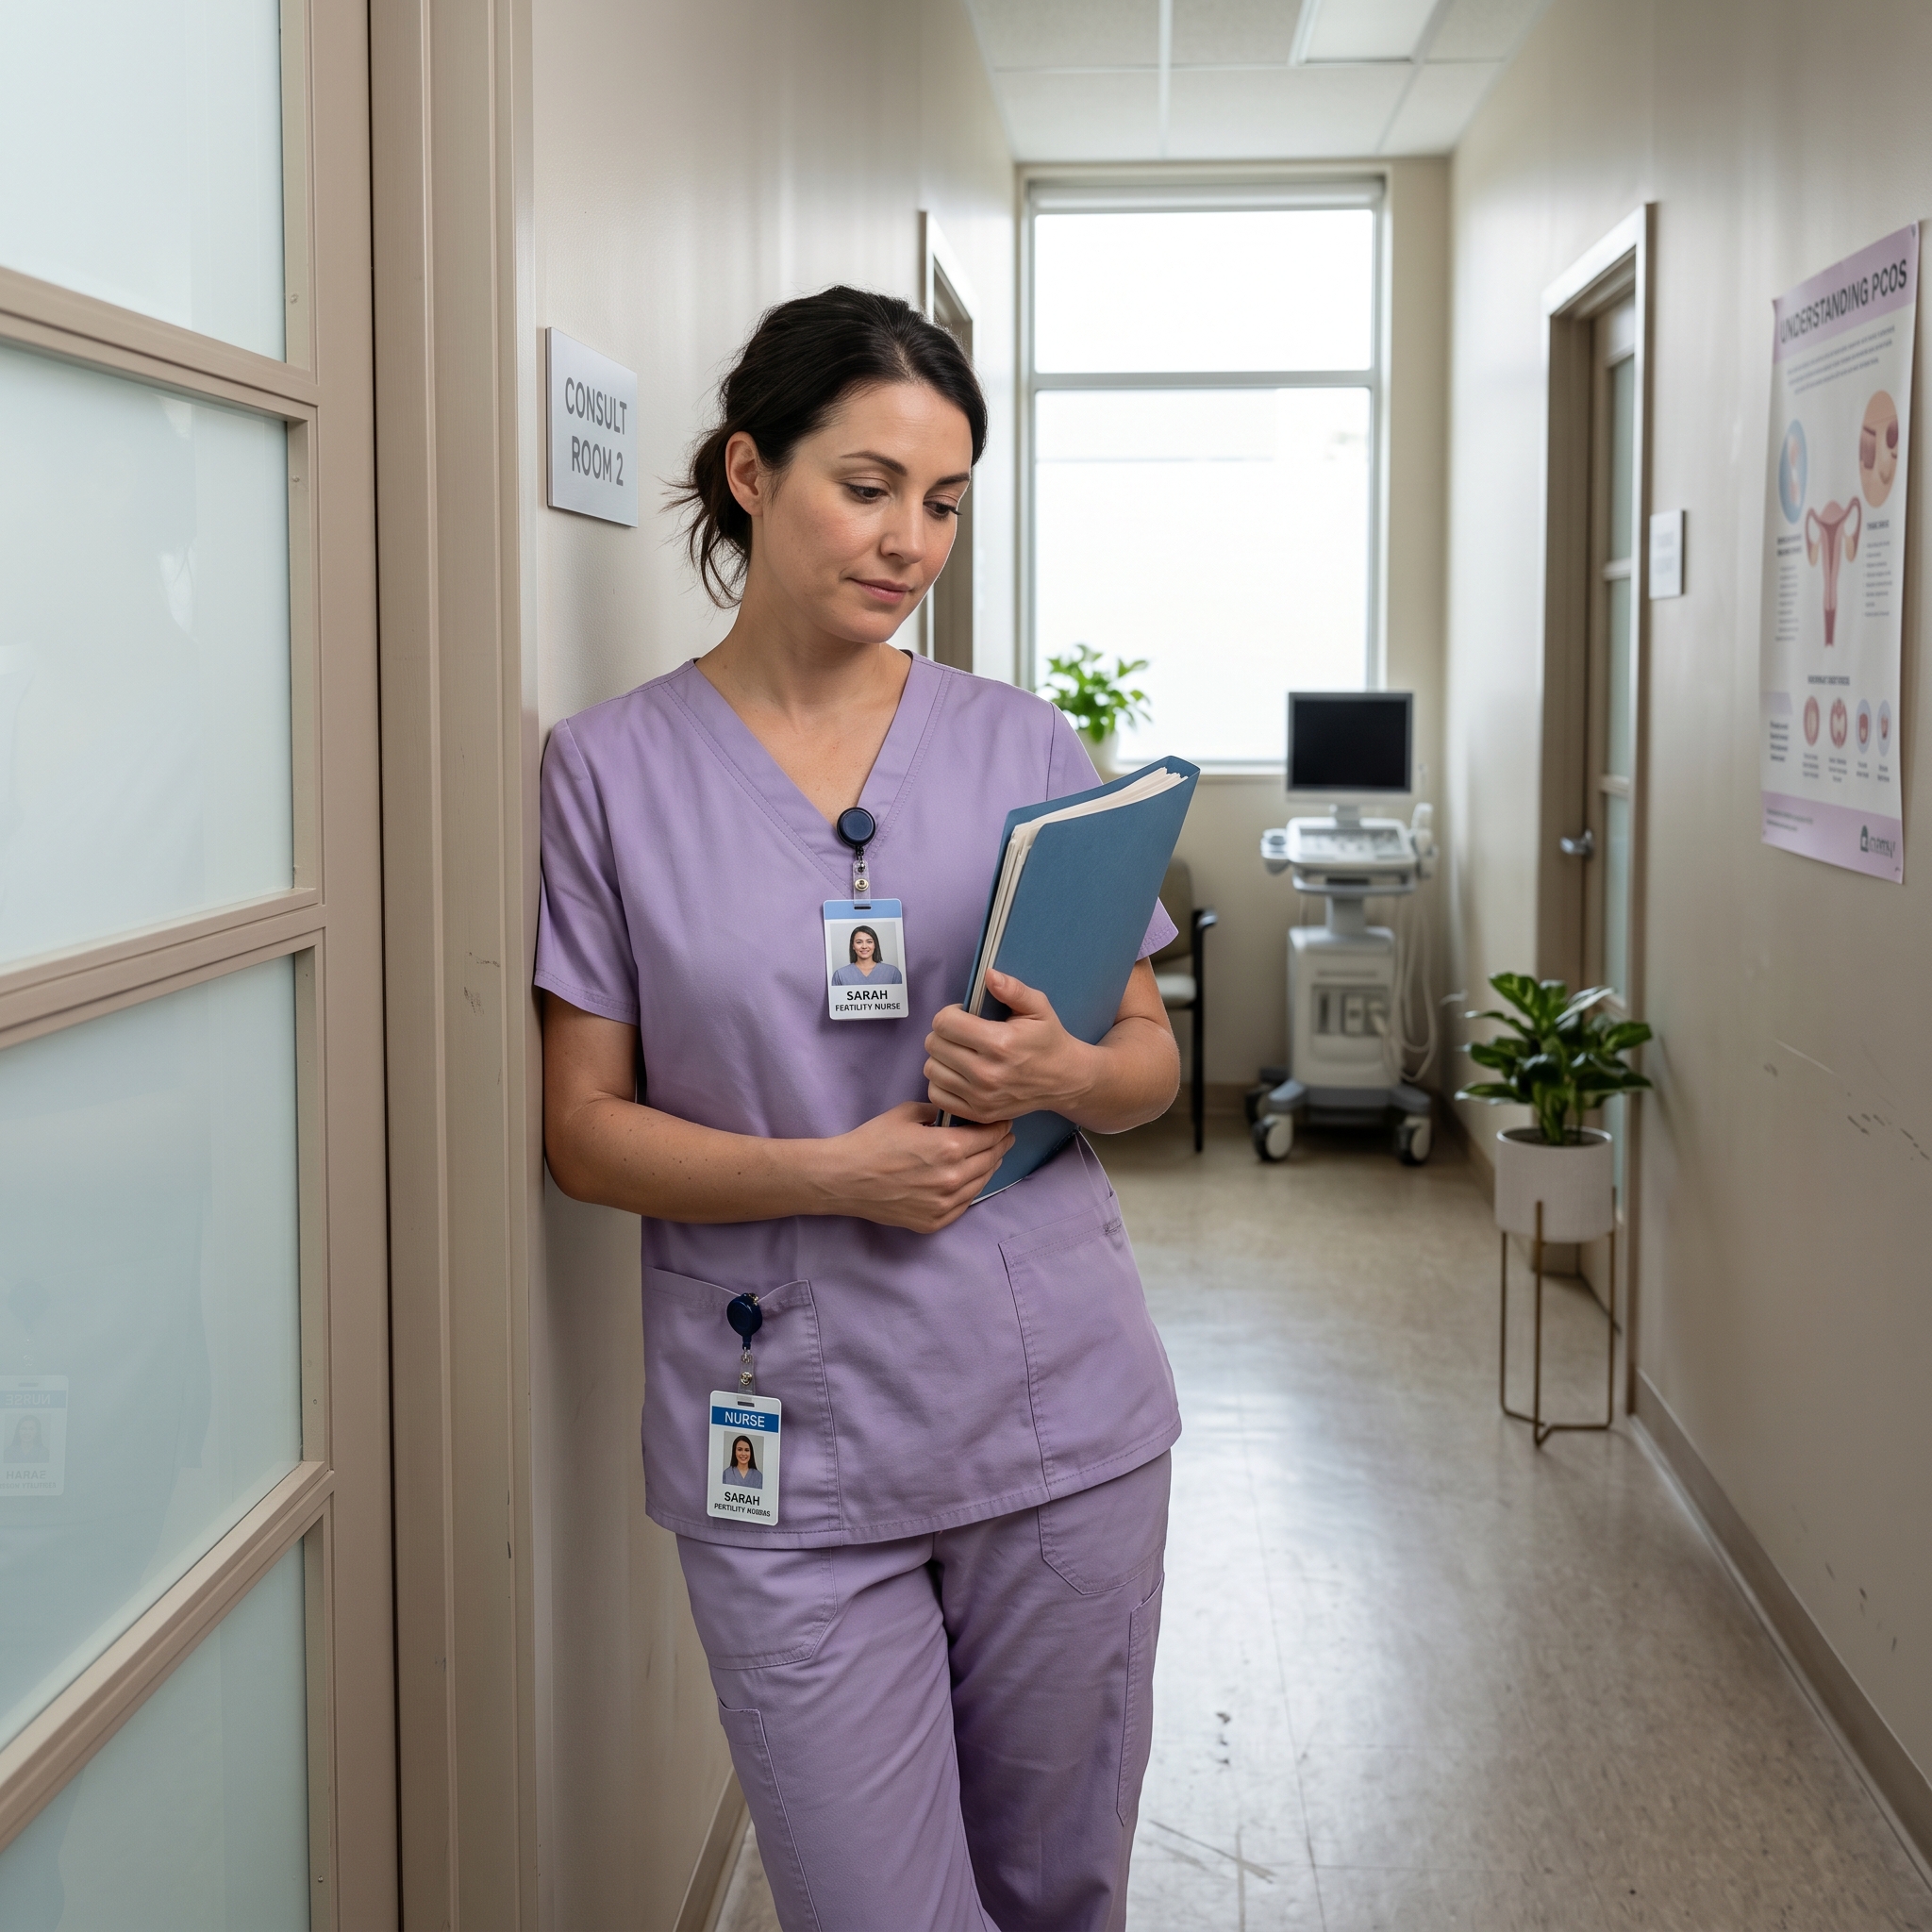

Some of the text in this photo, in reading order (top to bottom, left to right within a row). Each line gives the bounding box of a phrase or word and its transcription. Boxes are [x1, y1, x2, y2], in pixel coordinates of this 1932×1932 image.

[1779, 258, 1907, 344] UNDERSTANDING PCOS
[565, 376, 627, 435] CONSULT
[572, 435, 624, 487] ROOM 2
[846, 990, 888, 1001] SARAH
[874, 1002, 901, 1010] NURSE
[724, 1411, 765, 1428] NURSE
[724, 1491, 760, 1507] SARAH
